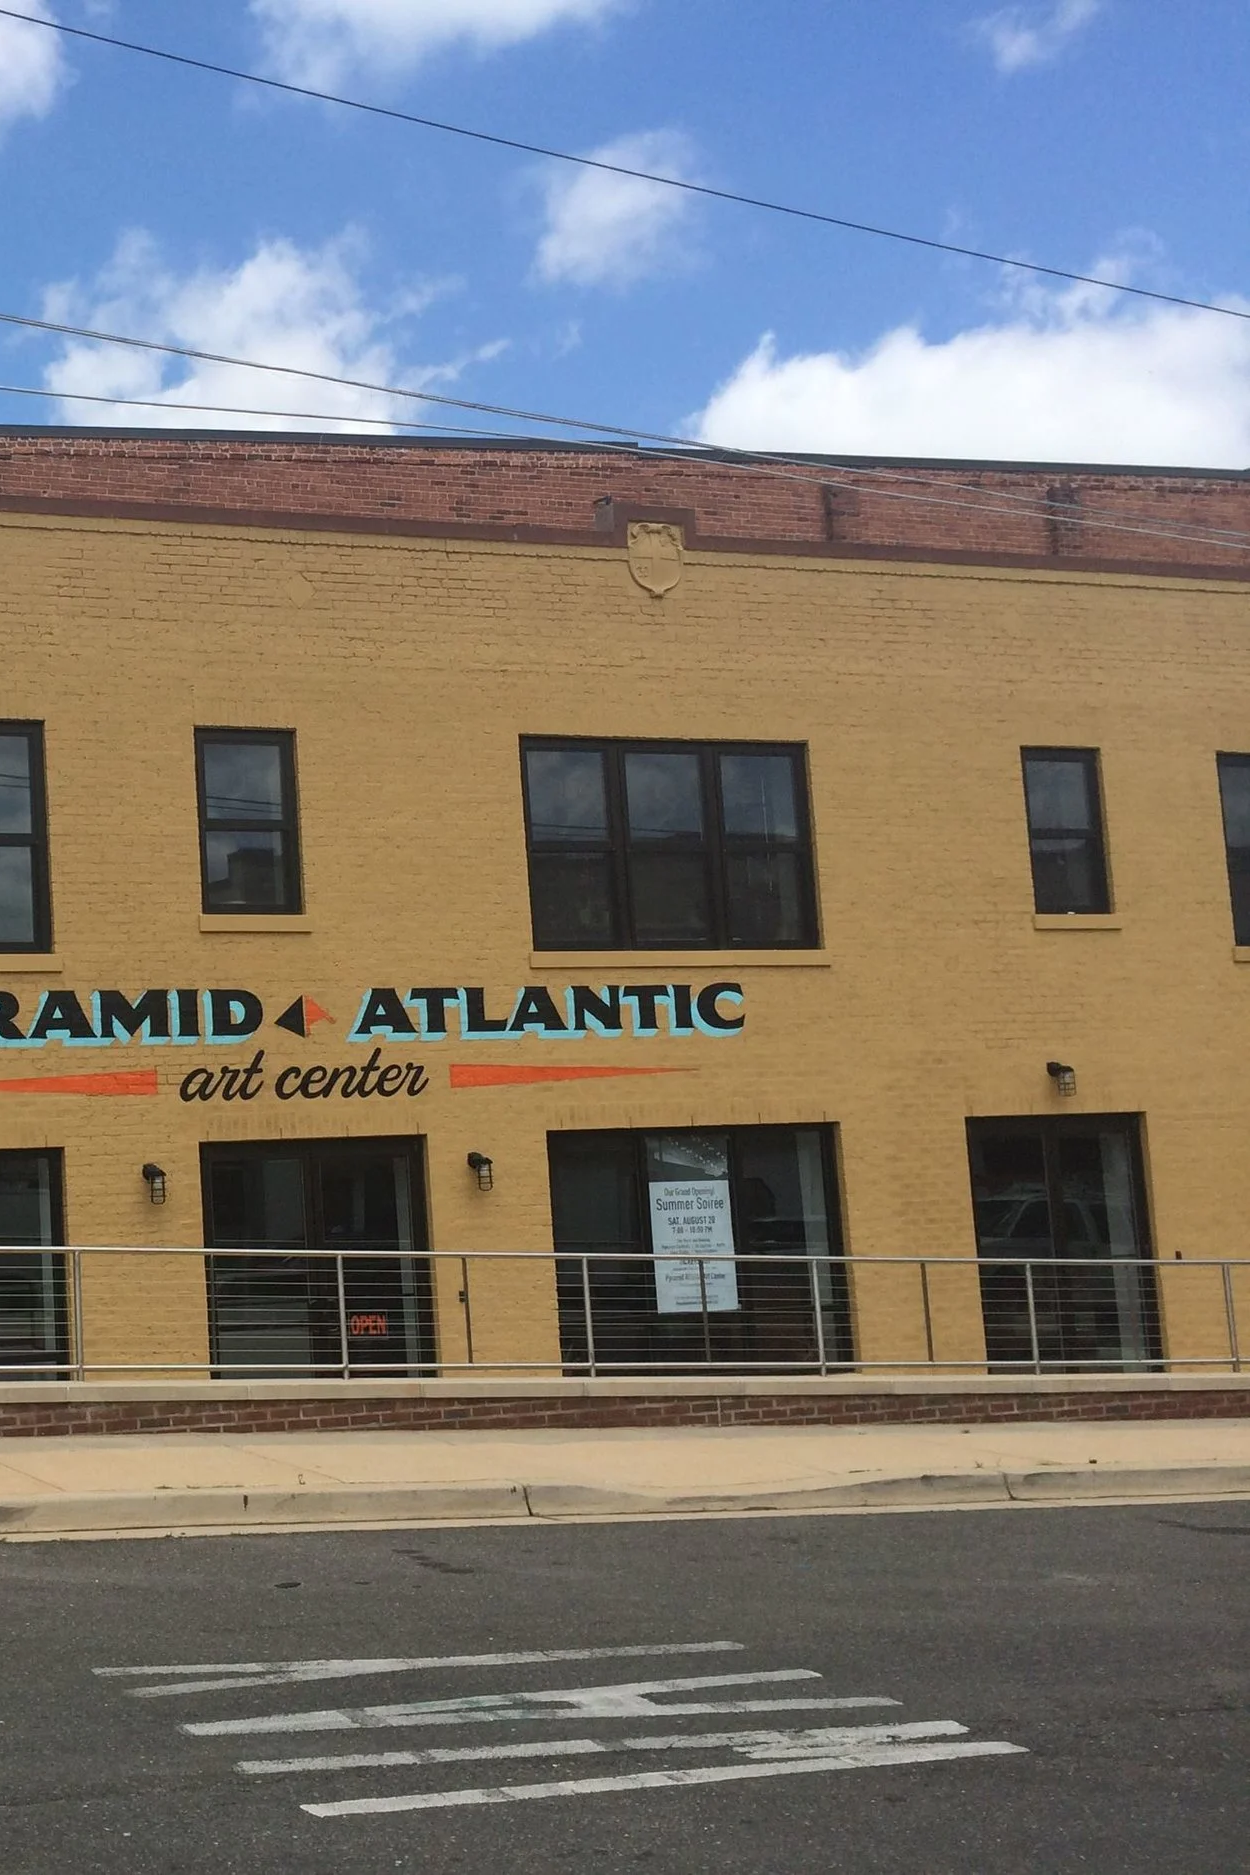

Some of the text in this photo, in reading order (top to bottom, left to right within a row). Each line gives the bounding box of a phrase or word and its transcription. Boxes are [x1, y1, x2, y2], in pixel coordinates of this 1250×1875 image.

[346, 982, 746, 1042] ATLANTIC
[180, 1047, 430, 1102] art center
[656, 1196, 724, 1211] Summer Soirée
[683, 1216, 707, 1225] AUGUST
[350, 1315, 386, 1335] OPEN
